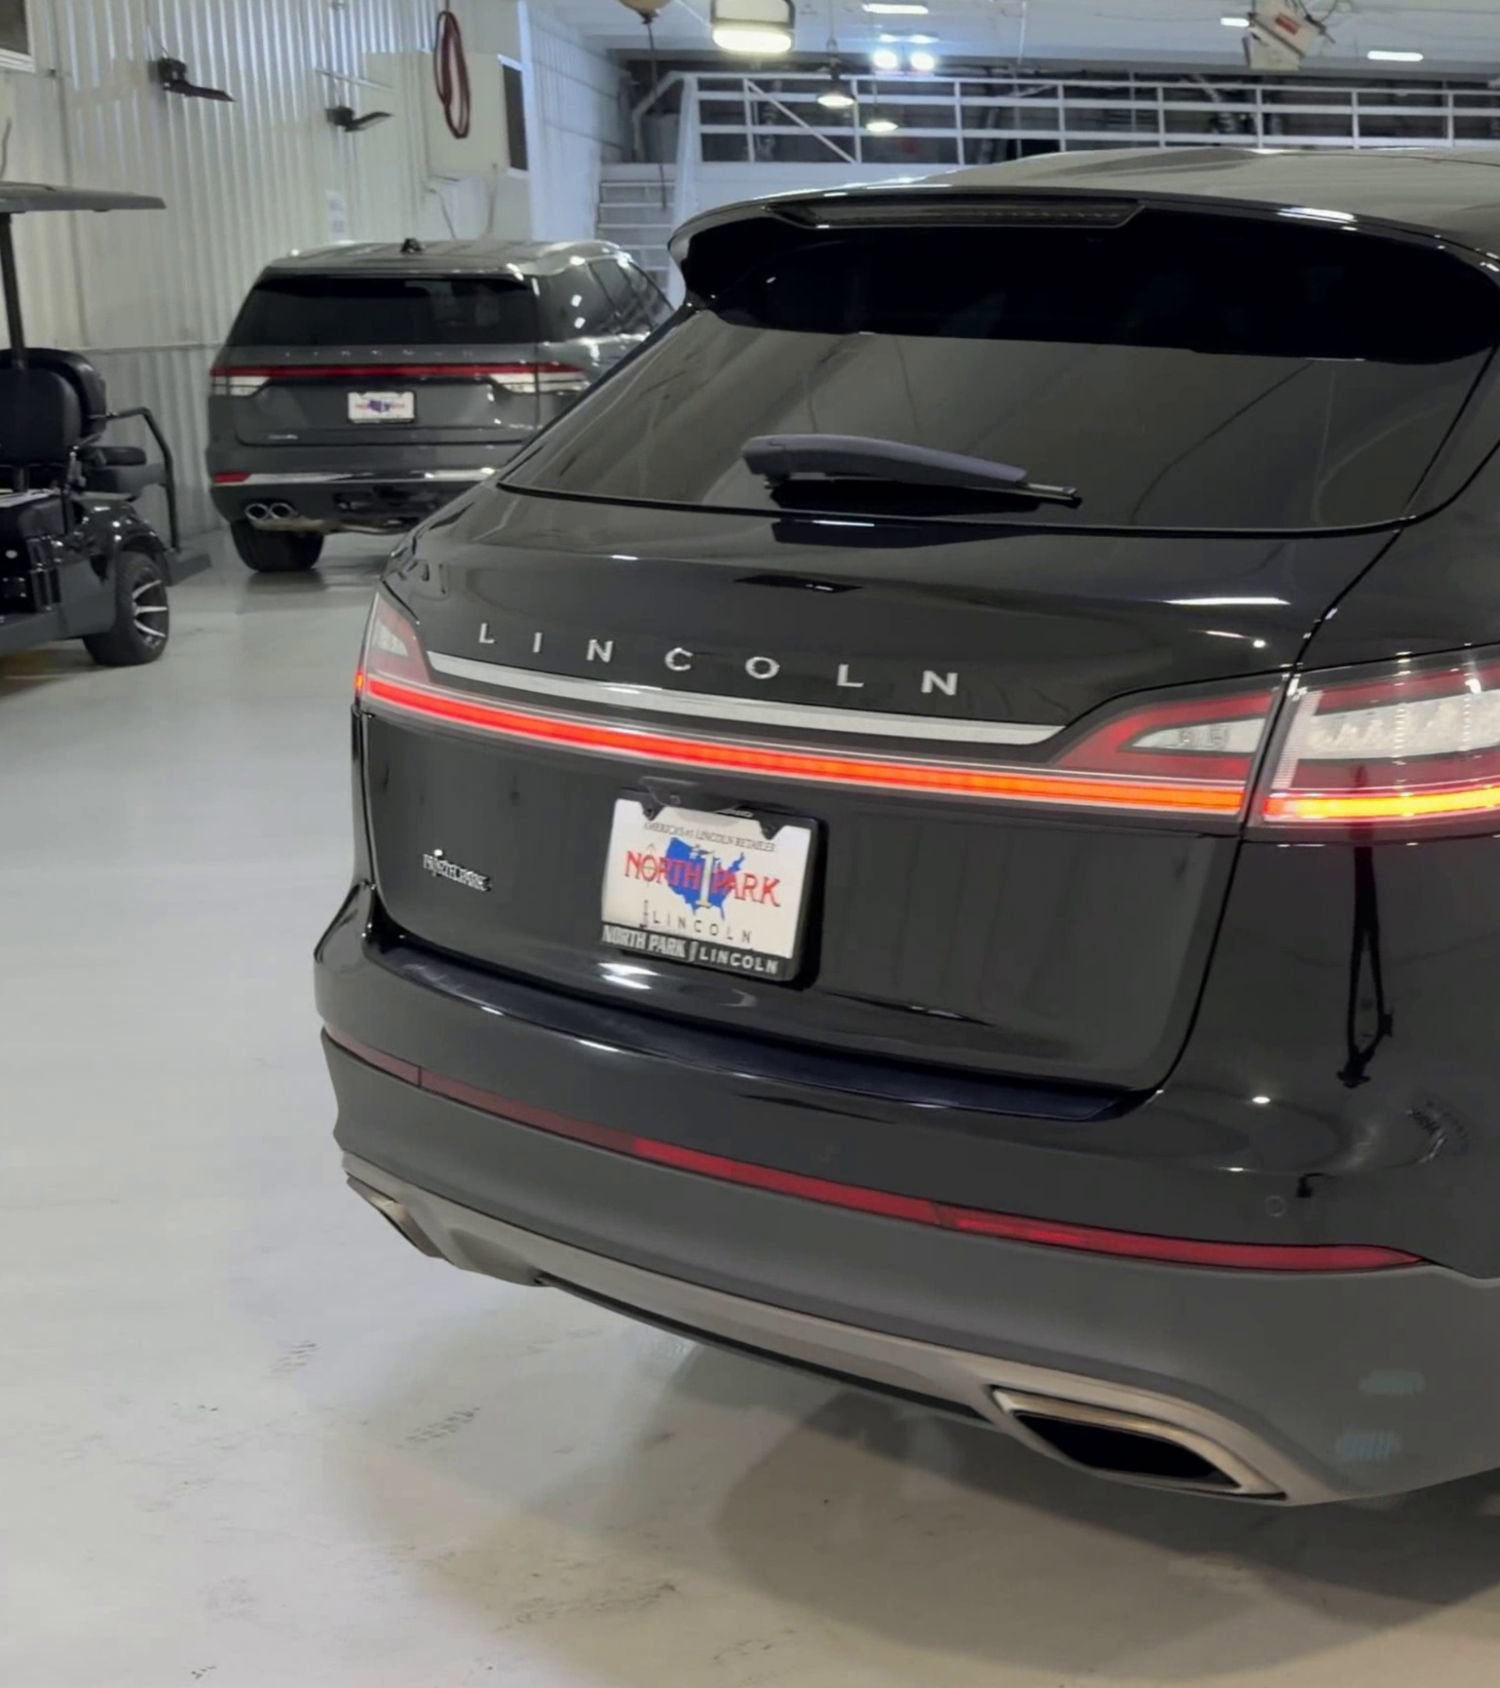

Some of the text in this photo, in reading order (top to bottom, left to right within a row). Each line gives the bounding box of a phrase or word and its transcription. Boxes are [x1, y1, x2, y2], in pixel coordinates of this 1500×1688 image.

[478, 622, 959, 696] LINCOLN
[624, 850, 781, 908] NORTH PARK
[602, 924, 778, 974] NORTH PARK LINCOLN
[653, 908, 752, 944] LINCOLN
